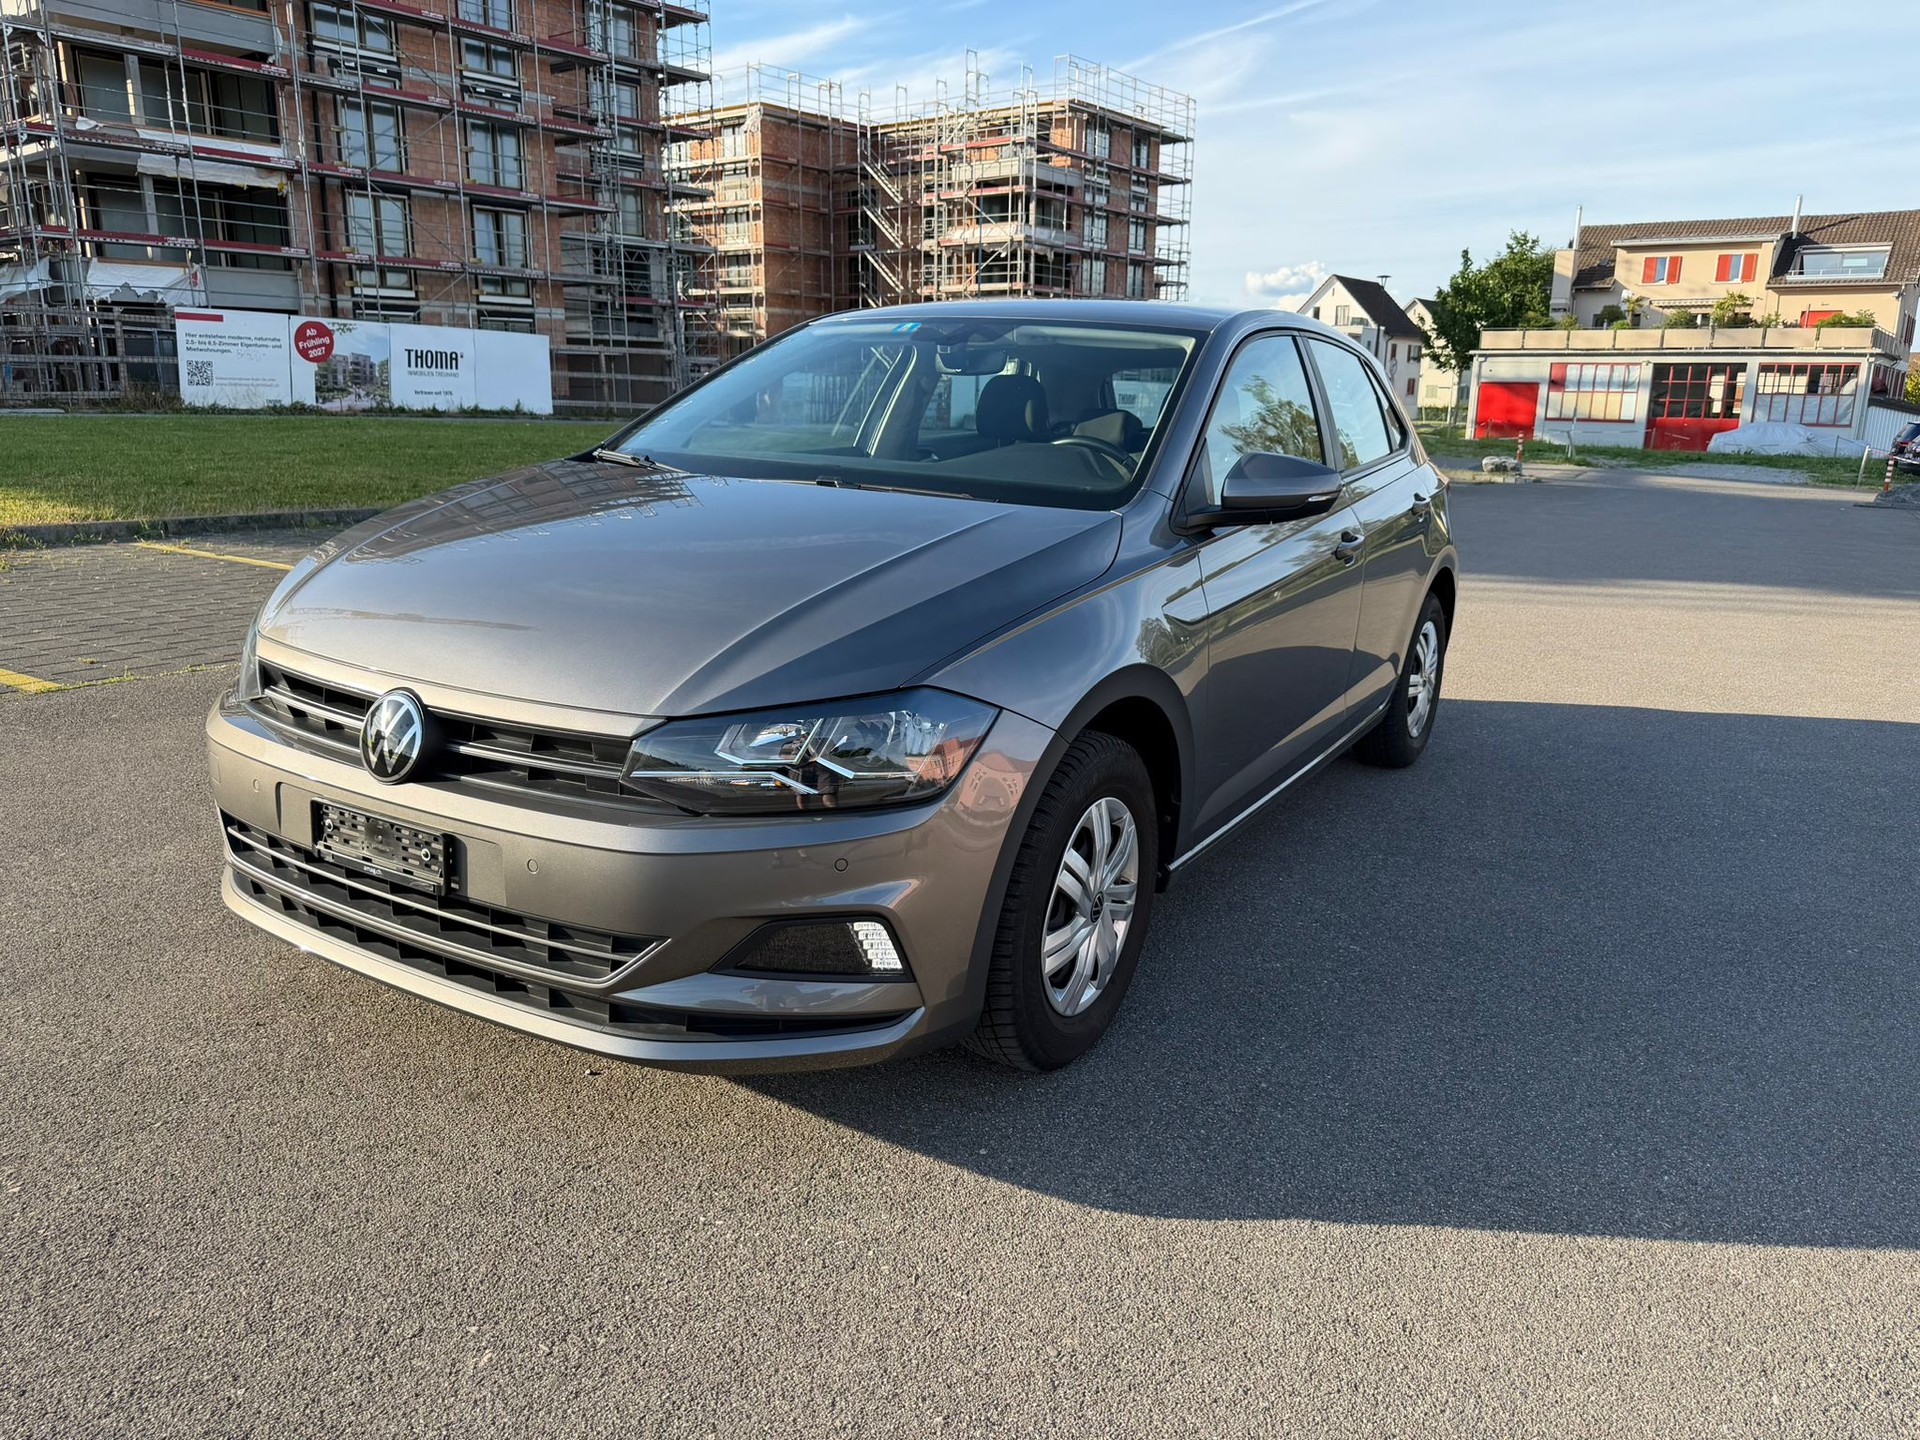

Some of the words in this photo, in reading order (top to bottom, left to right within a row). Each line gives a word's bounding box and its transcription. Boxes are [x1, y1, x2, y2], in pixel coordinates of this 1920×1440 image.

[306, 328, 317, 336] Ab
[227, 334, 253, 342] moderne,
[240, 341, 270, 349] Eigentums-
[299, 336, 330, 349] Frühling
[186, 346, 232, 354] Mietwohnungen.
[308, 347, 325, 358] 2027
[405, 349, 458, 370] THOMA
